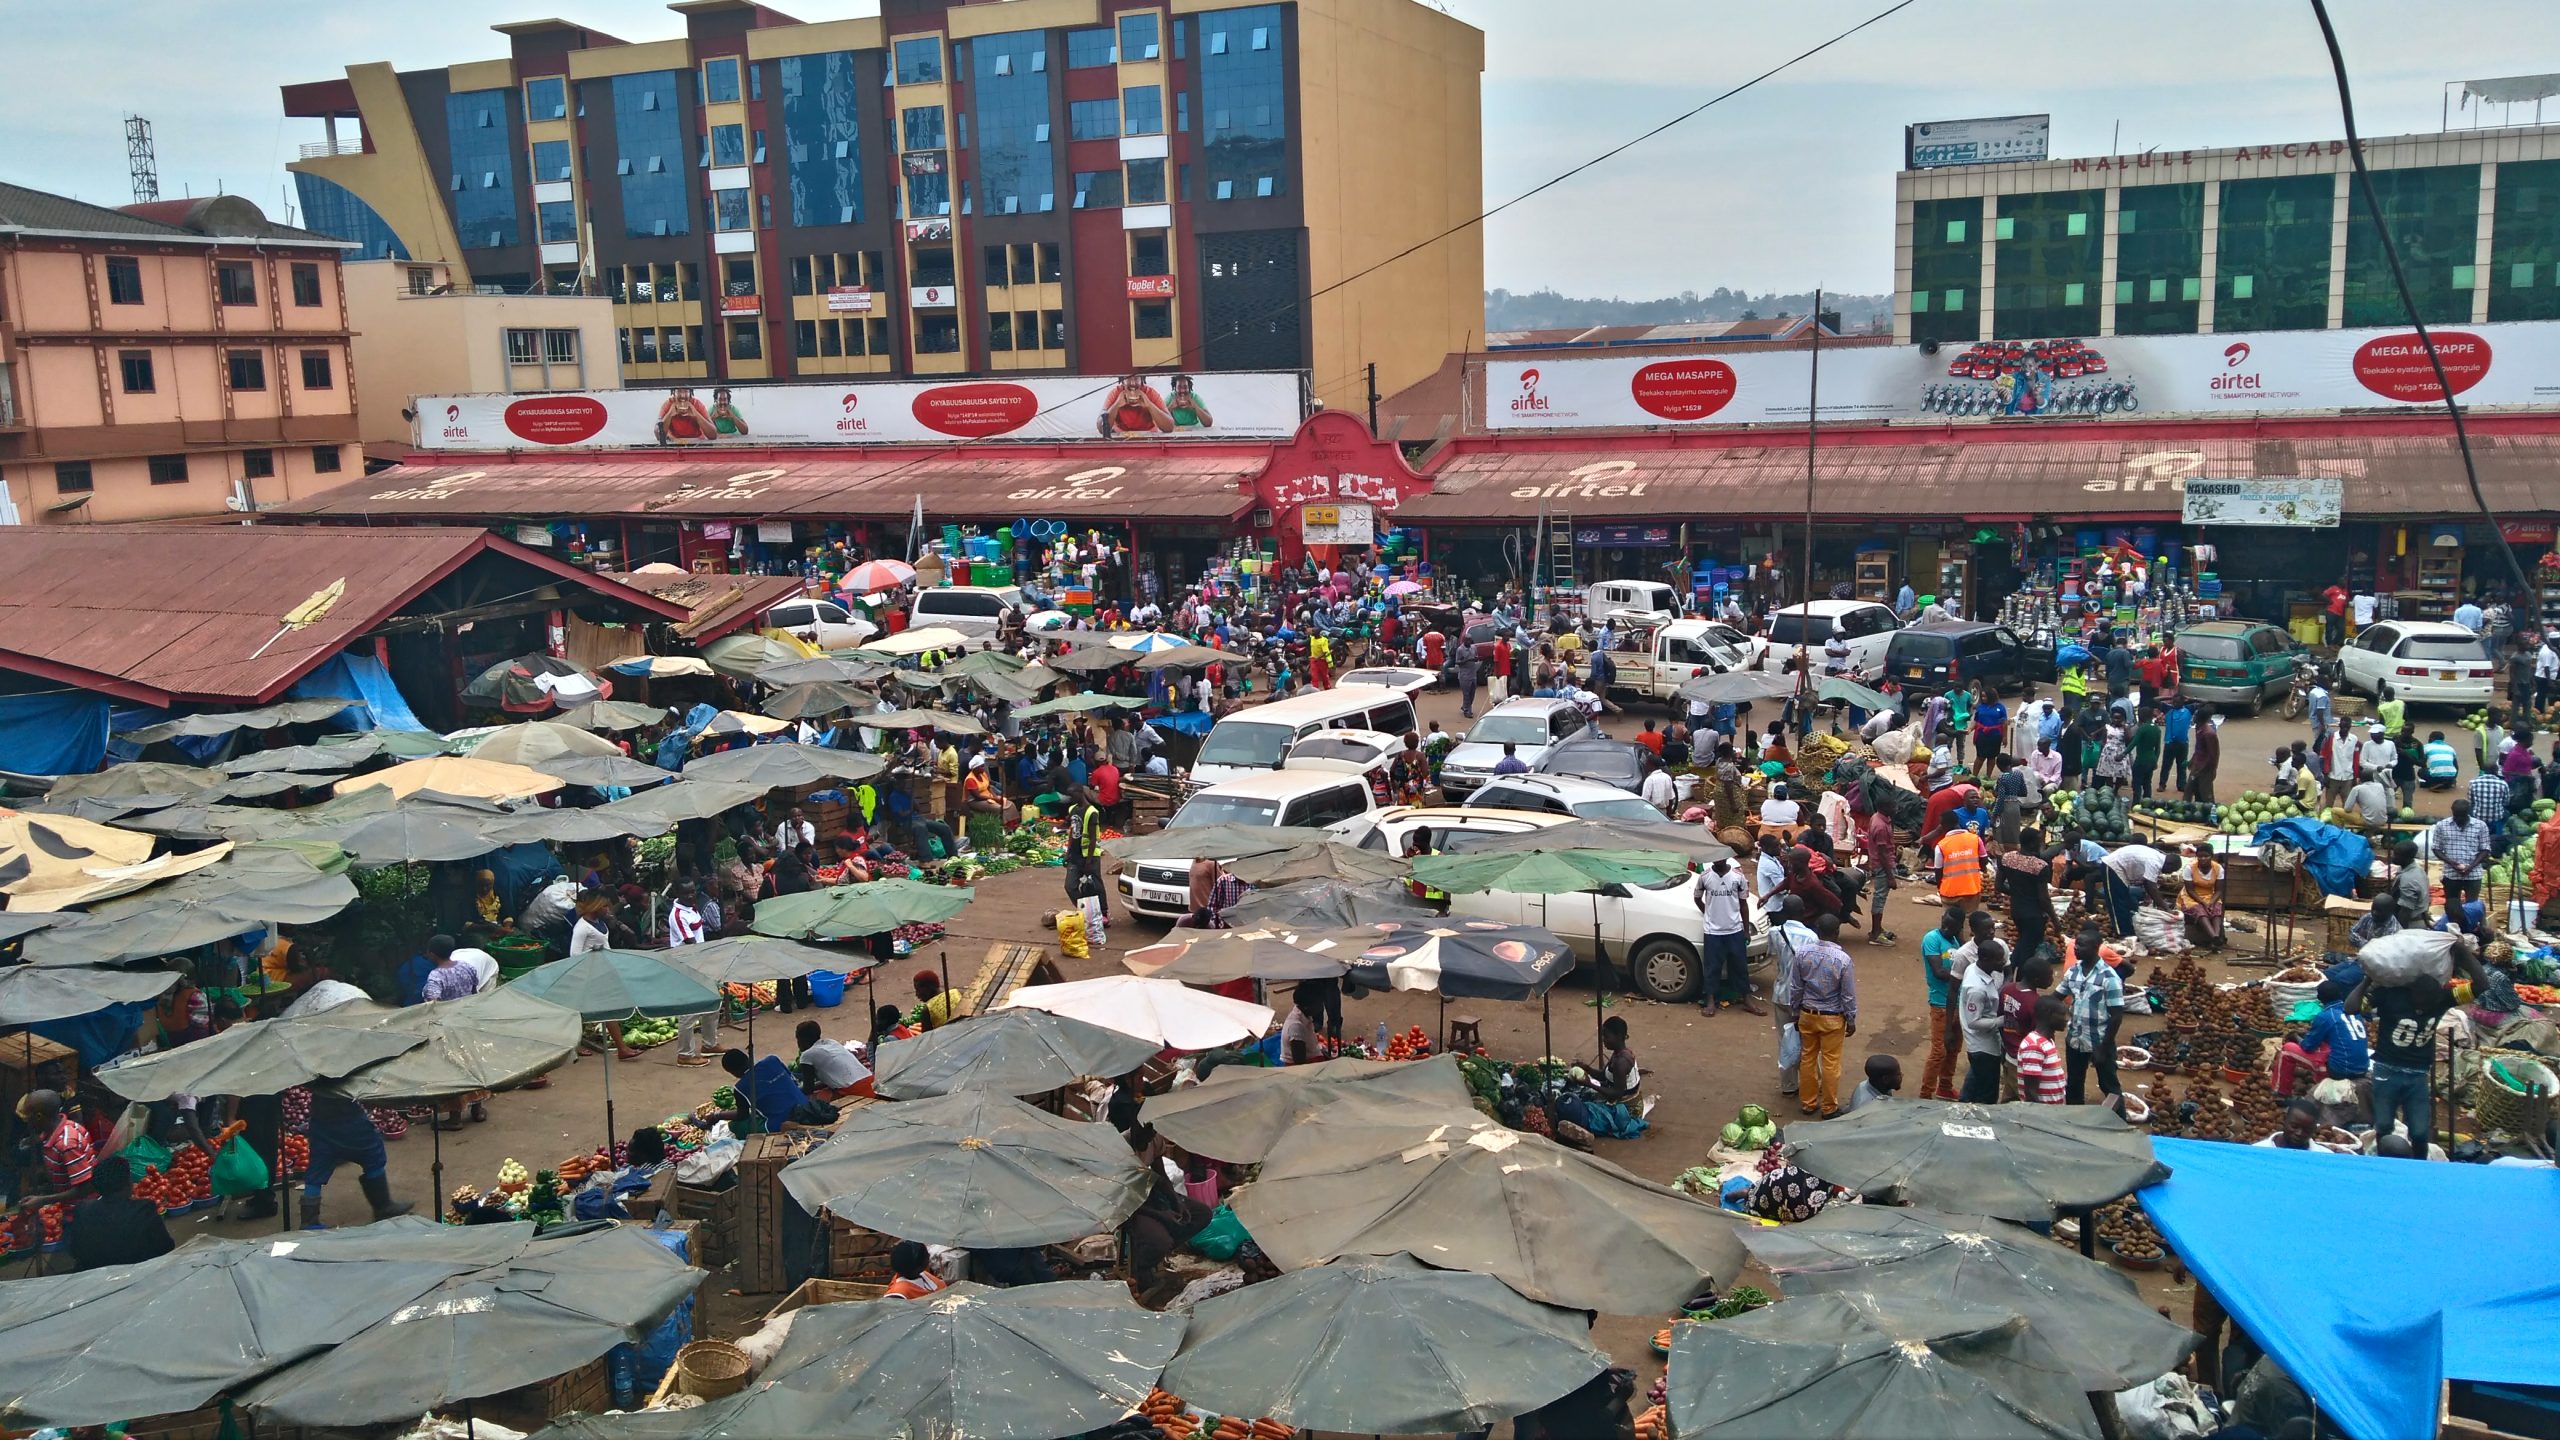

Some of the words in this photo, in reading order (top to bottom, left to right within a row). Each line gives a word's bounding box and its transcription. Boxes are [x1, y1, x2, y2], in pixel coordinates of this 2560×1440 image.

[2072, 151, 2192, 173] NALULE
[2235, 138, 2367, 162] ARCADE
[1128, 280, 1155, 291] TopBet
[2371, 346, 2409, 357] MEGA
[1645, 371, 1674, 381] MEGA
[1676, 370, 1724, 380] MASAPPE
[2362, 366, 2396, 375] Teekako
[2396, 365, 2437, 374] eyatayim
[2210, 373, 2262, 390] airtel
[2394, 383, 2417, 392] Nyiga
[1638, 389, 1665, 397] Teekako
[1665, 388, 1697, 397] eyatayimu
[1697, 388, 1729, 396] owangule
[1663, 404, 1682, 413] Nyiga
[836, 418, 867, 430] airtel
[443, 426, 468, 438] airtel
[2082, 475, 2185, 492] airt
[2187, 484, 2241, 495] NAKASERO
[369, 488, 463, 500] airtel
[664, 487, 769, 499] airtel
[1006, 486, 1125, 499] airtel
[1510, 482, 1647, 498] airtel
[2522, 522, 2551, 532] airtel
[1530, 950, 1557, 973] pepsi
[2340, 1013, 2367, 1041] 16
